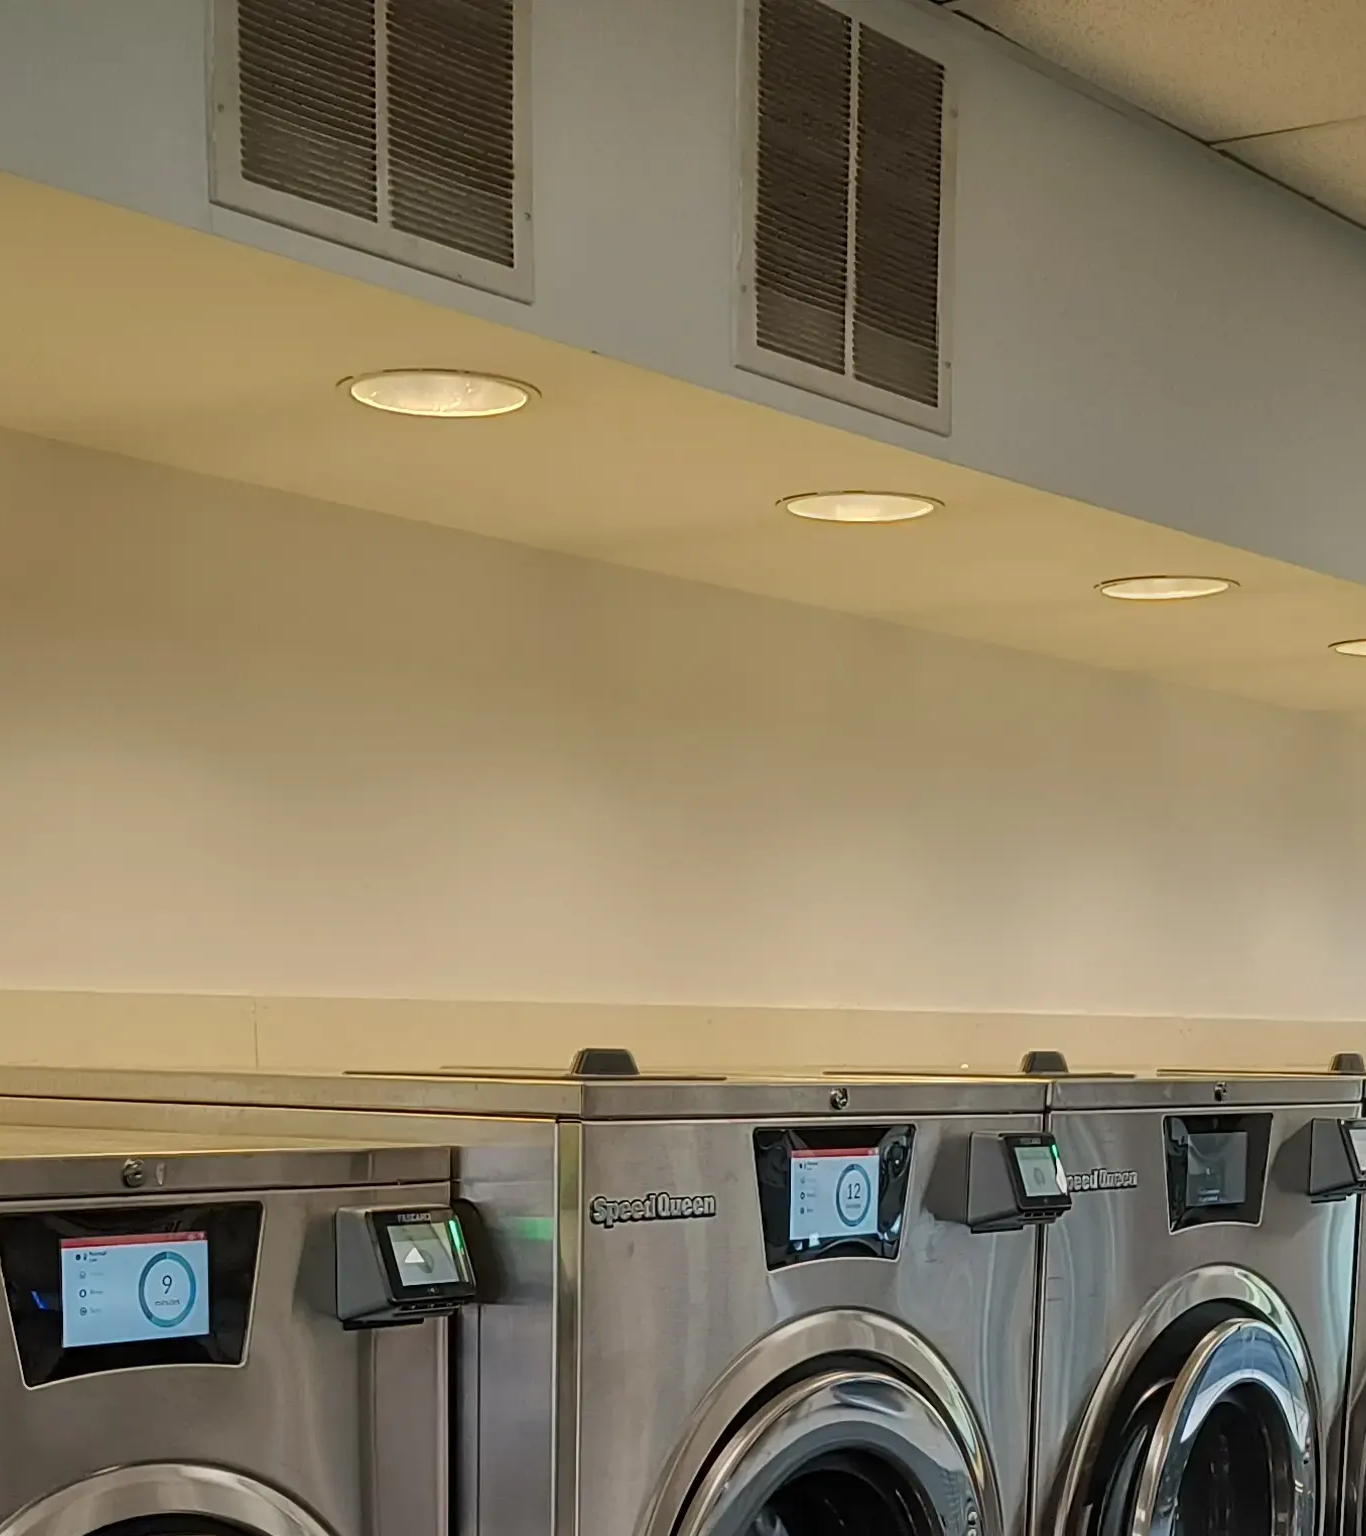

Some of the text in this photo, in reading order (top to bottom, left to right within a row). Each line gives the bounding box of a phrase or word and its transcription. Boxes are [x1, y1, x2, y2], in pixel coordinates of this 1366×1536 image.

[1065, 1168, 1098, 1192] peed
[847, 1183, 861, 1200] 12
[162, 1275, 173, 1295] 9
